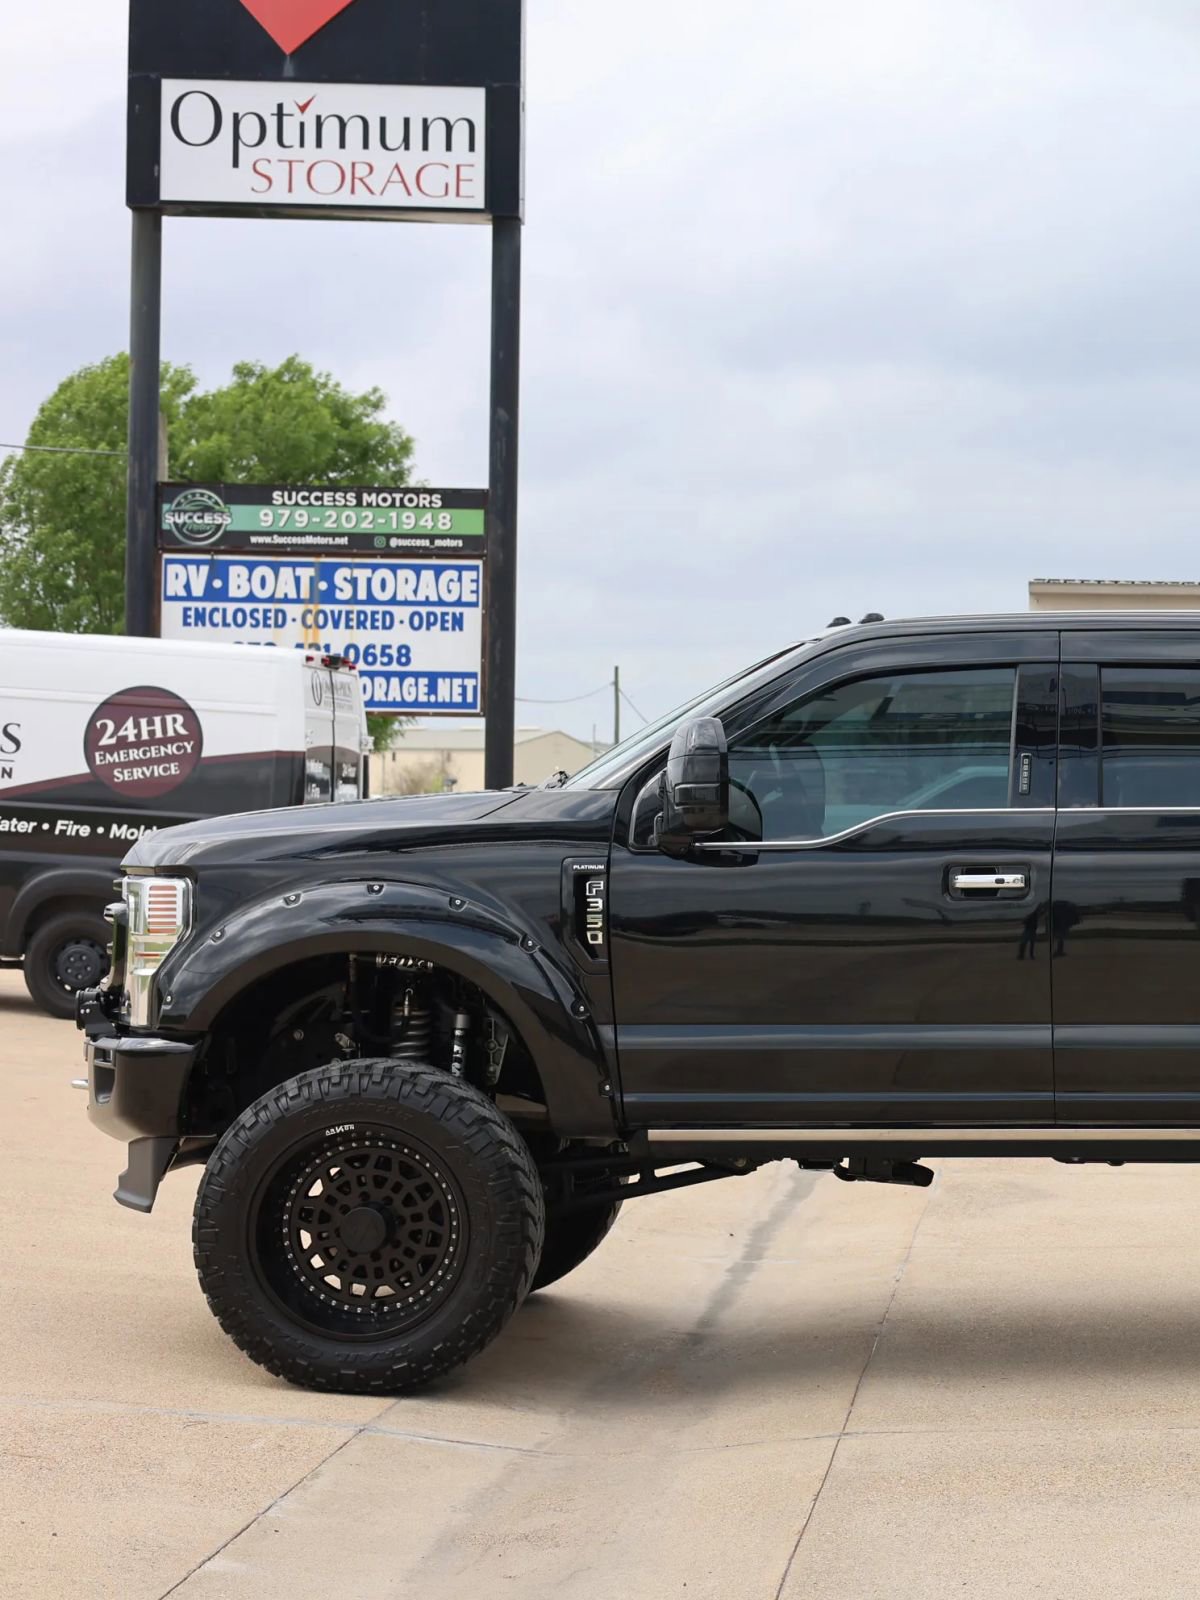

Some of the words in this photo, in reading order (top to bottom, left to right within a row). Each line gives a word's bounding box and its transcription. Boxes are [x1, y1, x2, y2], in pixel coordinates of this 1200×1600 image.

[170, 90, 476, 169] Optimum
[250, 158, 476, 199] STORAGE
[272, 490, 357, 506] SUCCESS
[362, 492, 443, 508] MOTORS
[164, 511, 232, 525] SUCCESS
[259, 509, 453, 530] 979-202-1948
[250, 534, 349, 545] www.SuccessMotors.net
[389, 536, 463, 549] @success_motors
[165, 564, 210, 598] RV
[228, 565, 315, 600] BOAT
[334, 567, 478, 603] STORAGE
[182, 607, 287, 630] ENCLOSED
[301, 609, 395, 631] COVERED
[408, 611, 465, 632] OPEN
[359, 676, 477, 703] ORAGE.NET
[96, 713, 190, 746] 24HR
[94, 741, 195, 766] EMERGENCY
[113, 762, 180, 782] SERVICE
[0, 816, 38, 833] ater
[54, 820, 91, 837] Fire
[109, 822, 158, 841] Mol
[585, 880, 604, 945] F350
